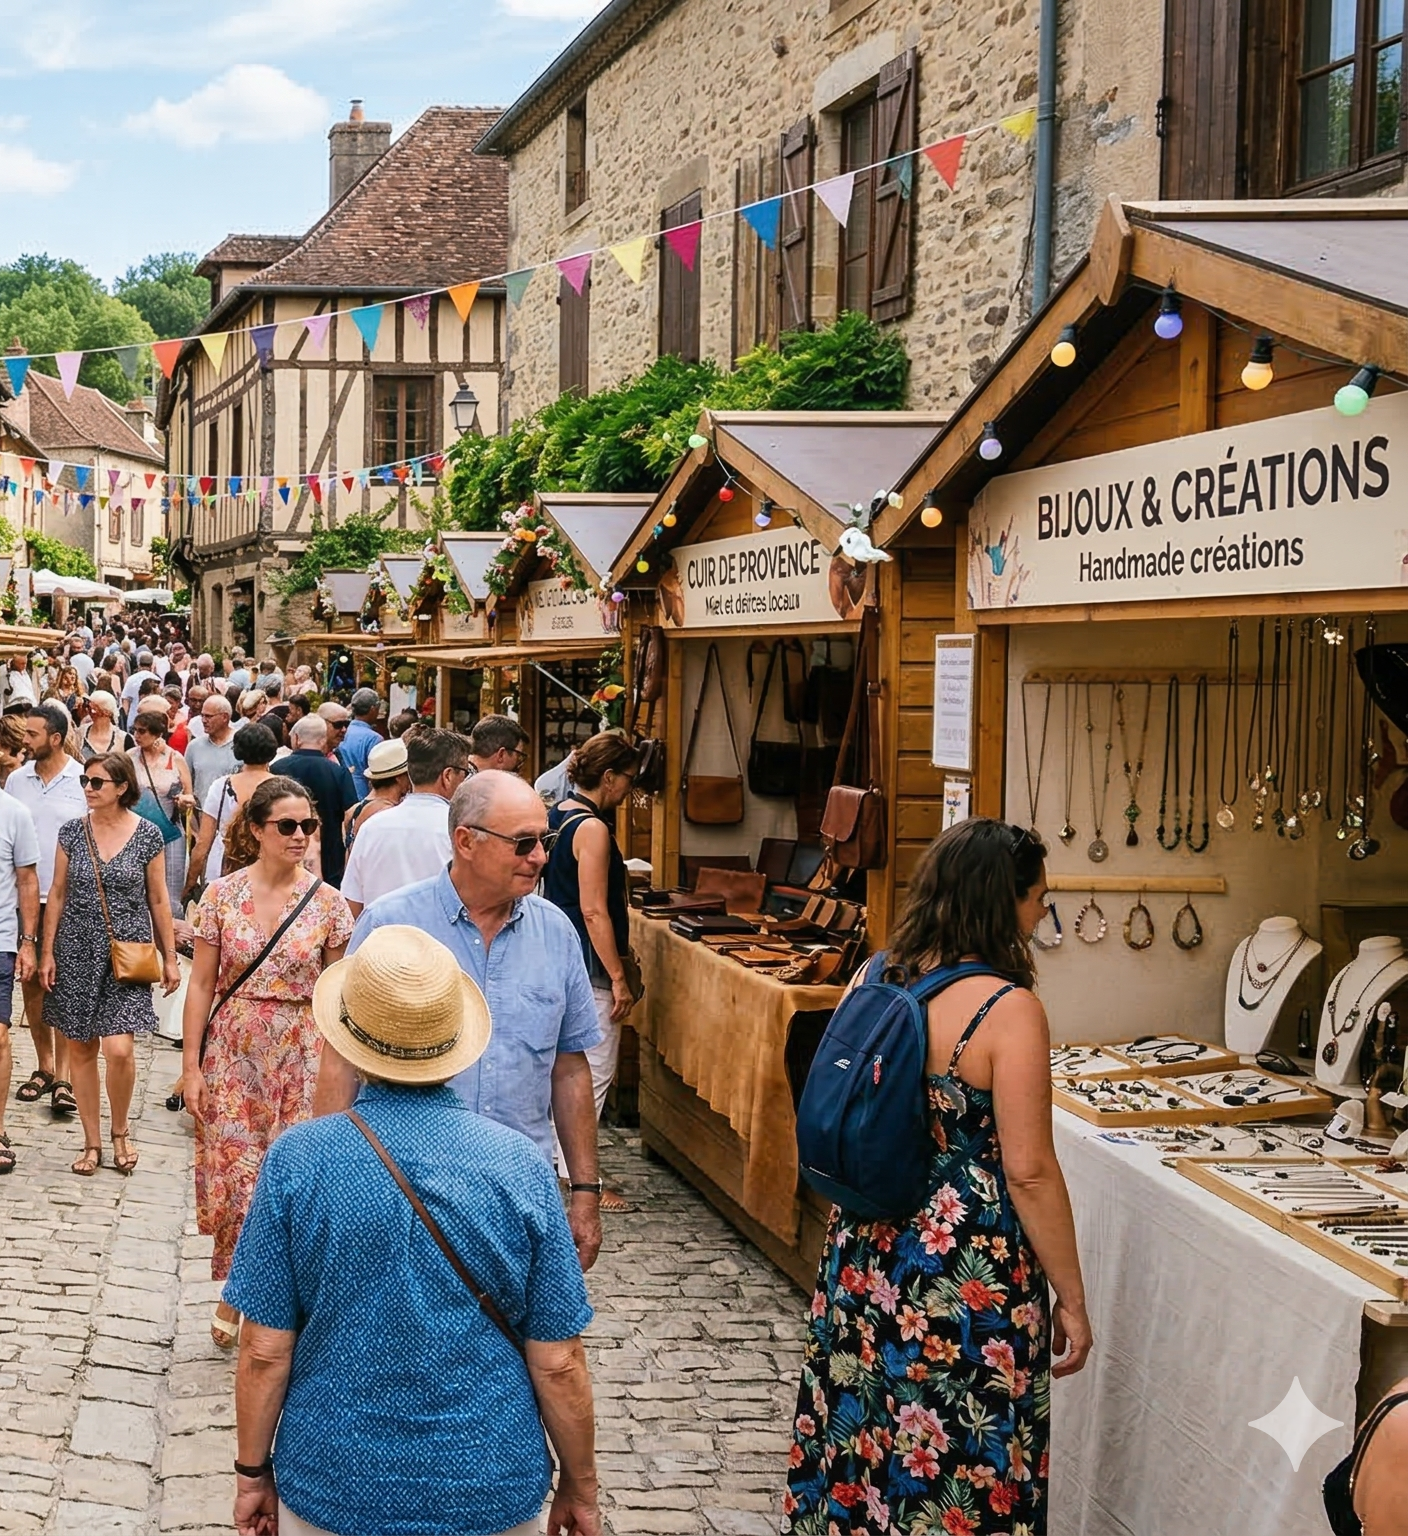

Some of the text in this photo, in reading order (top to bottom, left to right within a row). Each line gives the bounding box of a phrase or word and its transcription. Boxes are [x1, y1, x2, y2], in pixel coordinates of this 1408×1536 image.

[1038, 435, 1390, 541] BIJOUX & CRÉATIONS
[687, 538, 821, 589] CUIR DE PROVENCE
[1079, 532, 1303, 583] Handmade créations
